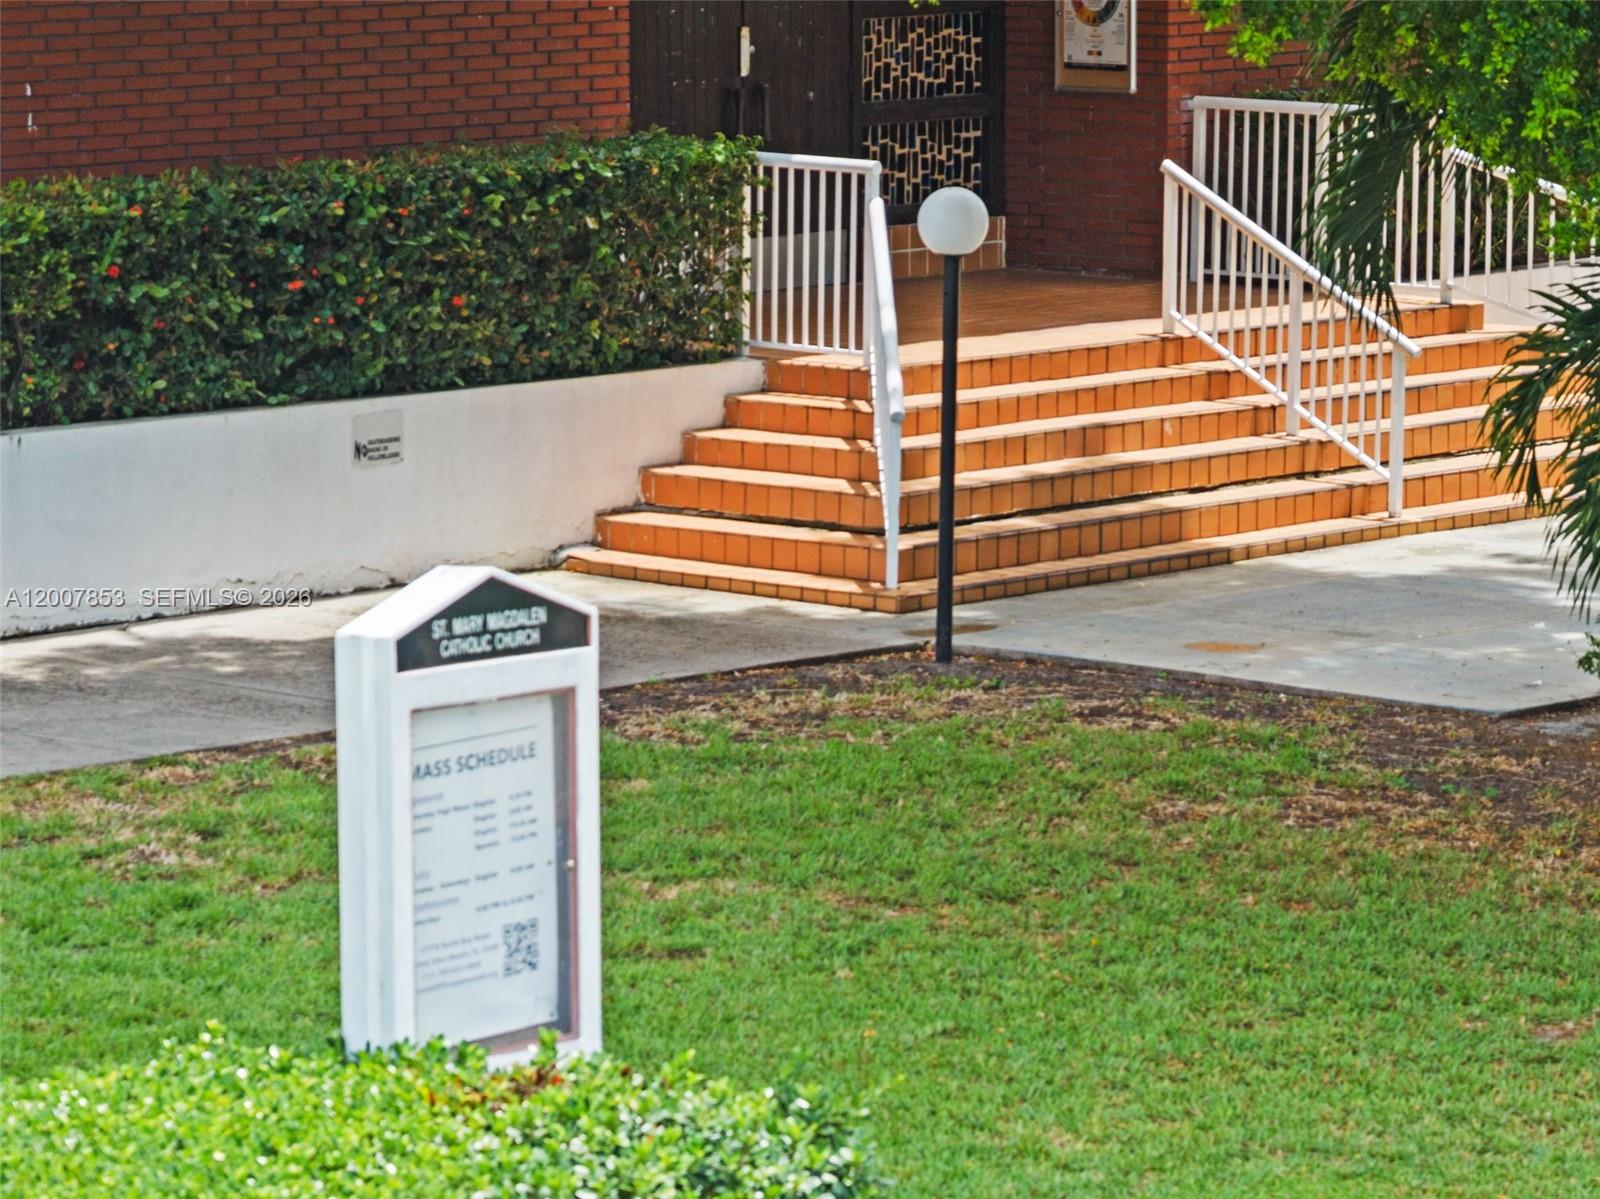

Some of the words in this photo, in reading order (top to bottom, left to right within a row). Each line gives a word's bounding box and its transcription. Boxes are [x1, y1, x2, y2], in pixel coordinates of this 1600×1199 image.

[431, 618, 448, 640] ST.
[452, 613, 484, 636] MARY
[486, 606, 548, 631] MAGDALEN
[440, 634, 492, 659] CATHOLIC
[494, 627, 541, 650] CHURCH
[456, 741, 537, 772] SCHEDULE
